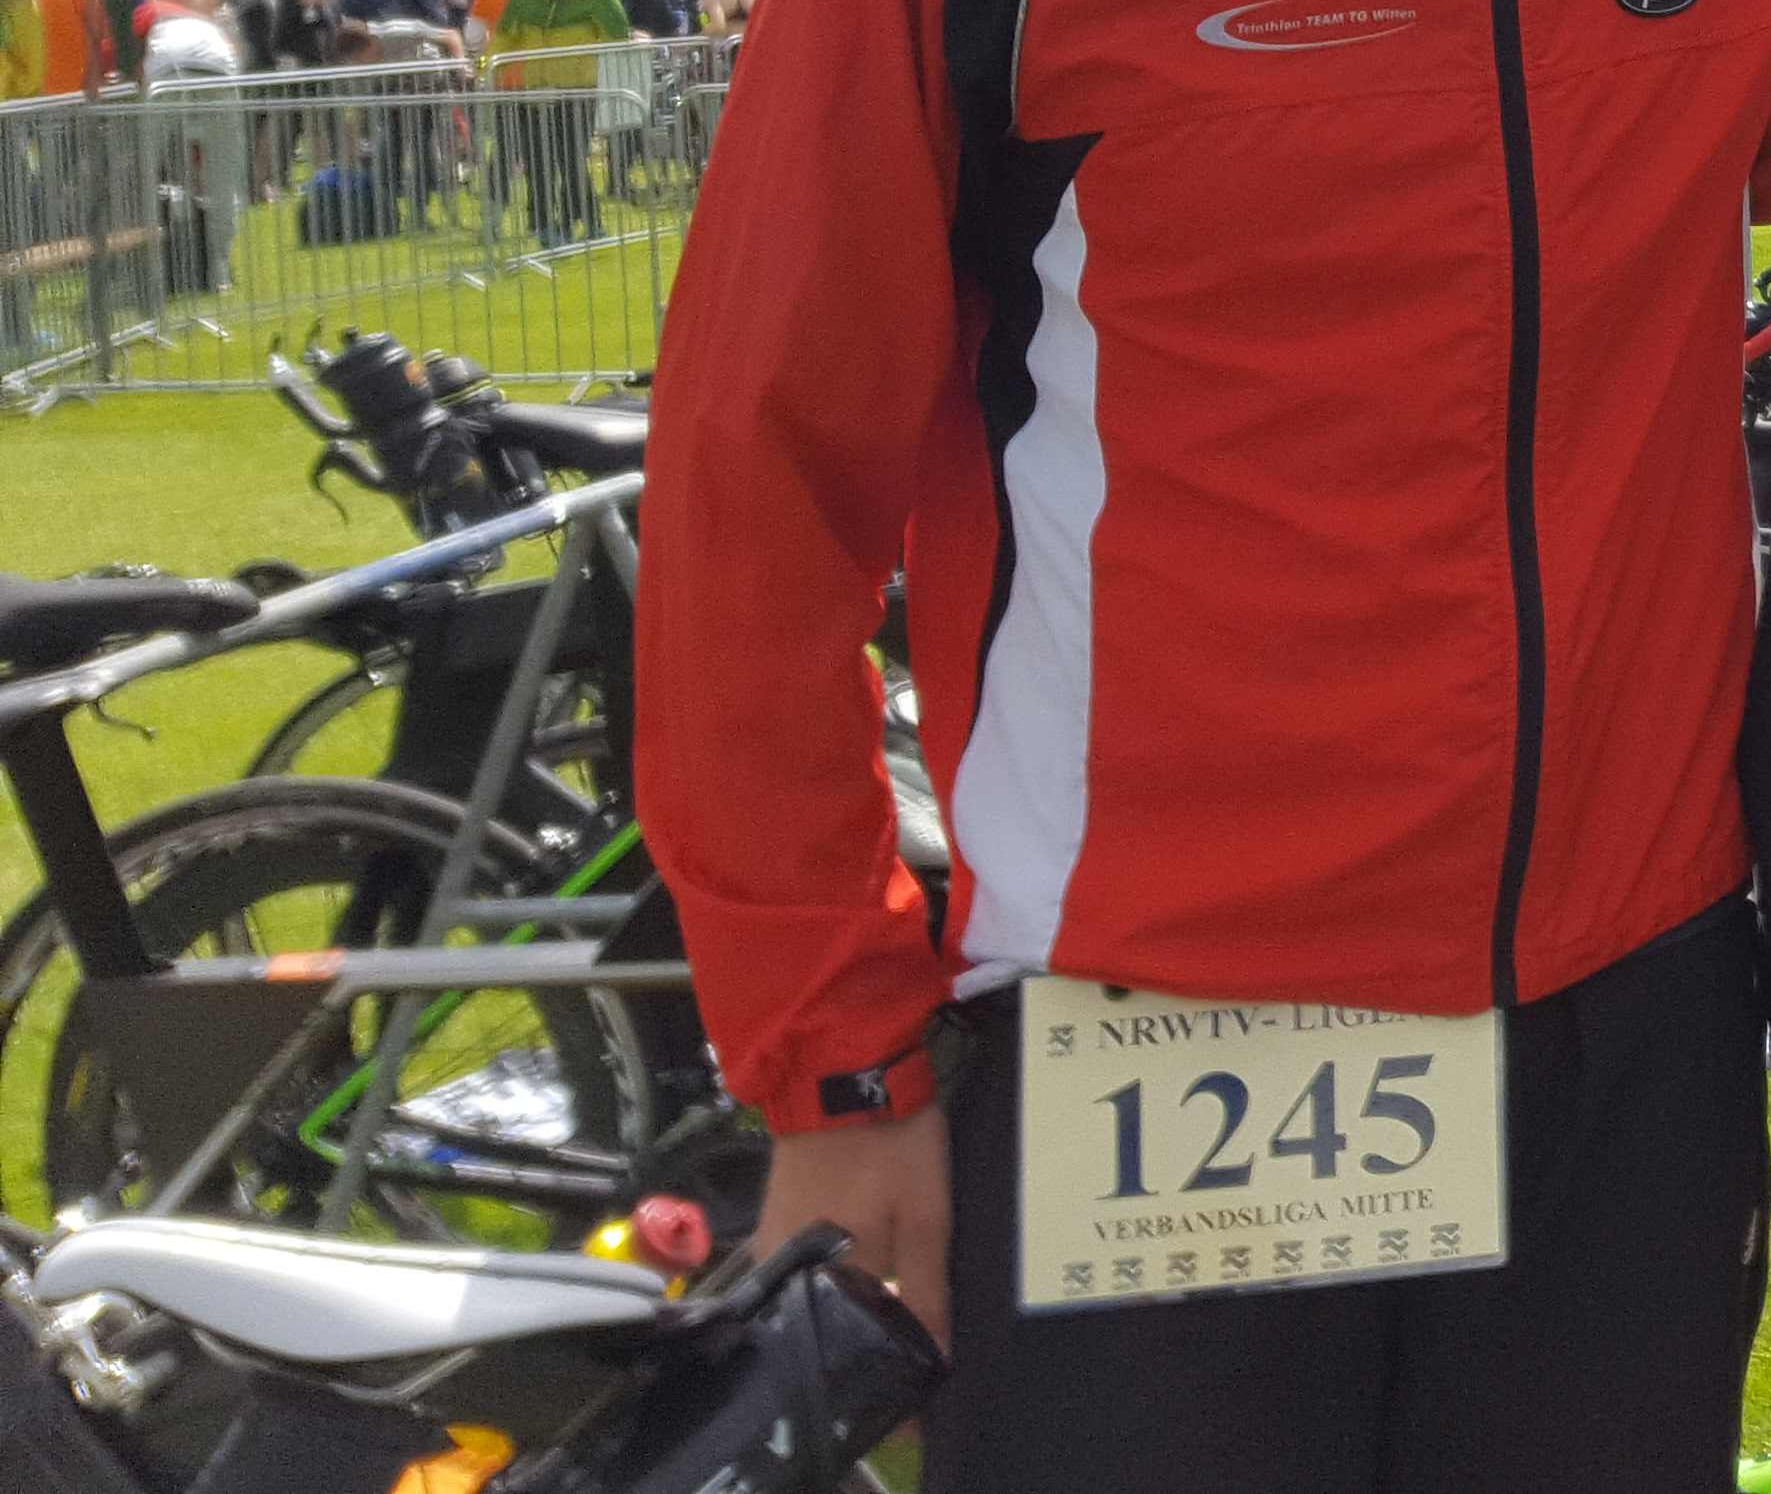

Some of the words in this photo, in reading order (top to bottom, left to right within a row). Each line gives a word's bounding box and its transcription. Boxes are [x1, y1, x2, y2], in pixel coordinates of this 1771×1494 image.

[1305, 14, 1345, 27] TEAM
[1093, 1053, 1436, 1201] 1245
[1093, 1201, 1328, 1242] VERBANDSLIGA
[1340, 1188, 1433, 1218] MITTE
